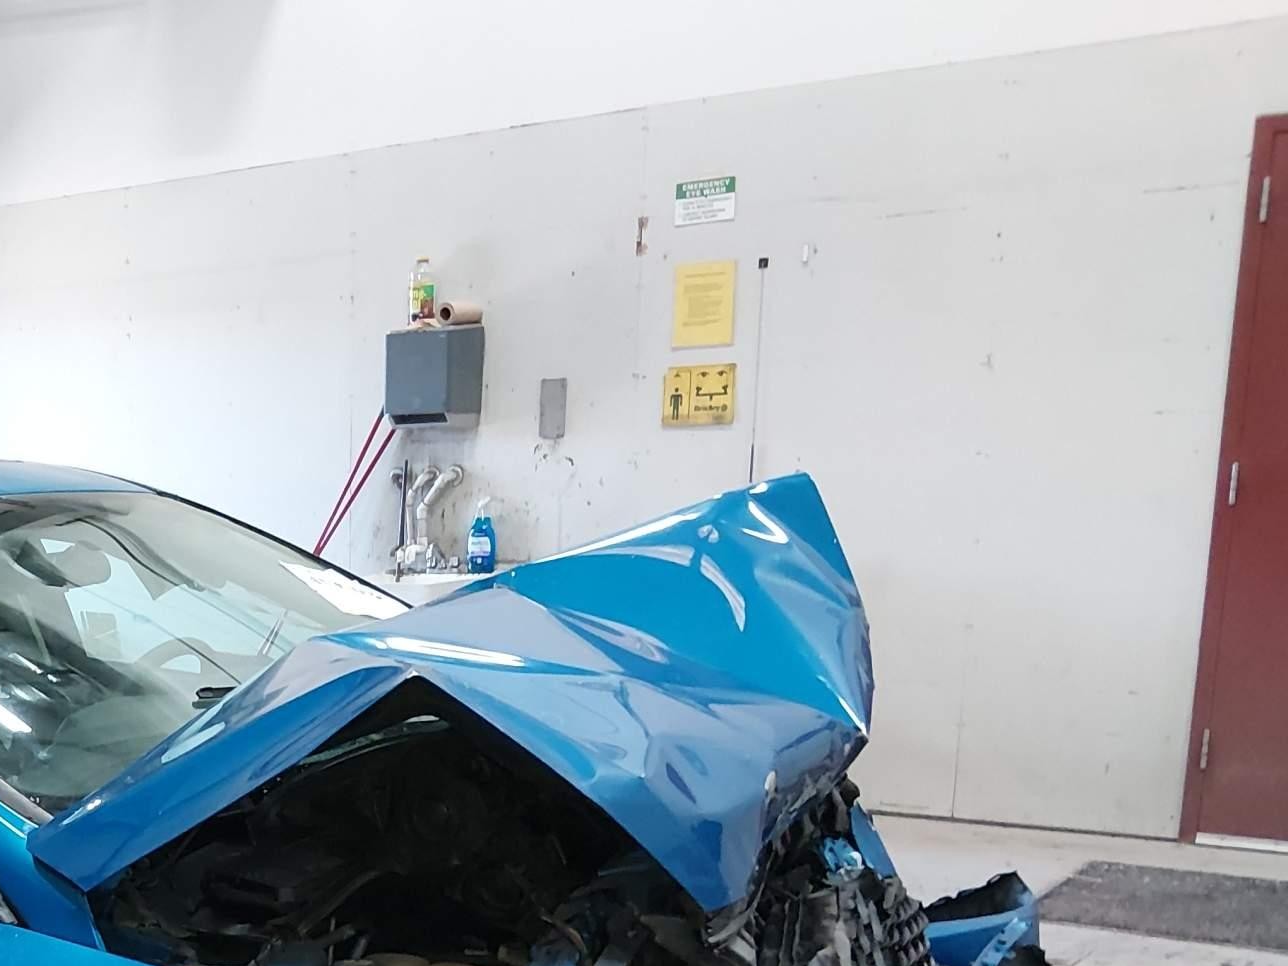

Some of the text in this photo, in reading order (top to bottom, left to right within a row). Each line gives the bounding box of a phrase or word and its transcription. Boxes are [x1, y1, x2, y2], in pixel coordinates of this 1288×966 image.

[682, 178, 730, 191] EMERGENCY
[686, 186, 727, 198] EYE WASH
